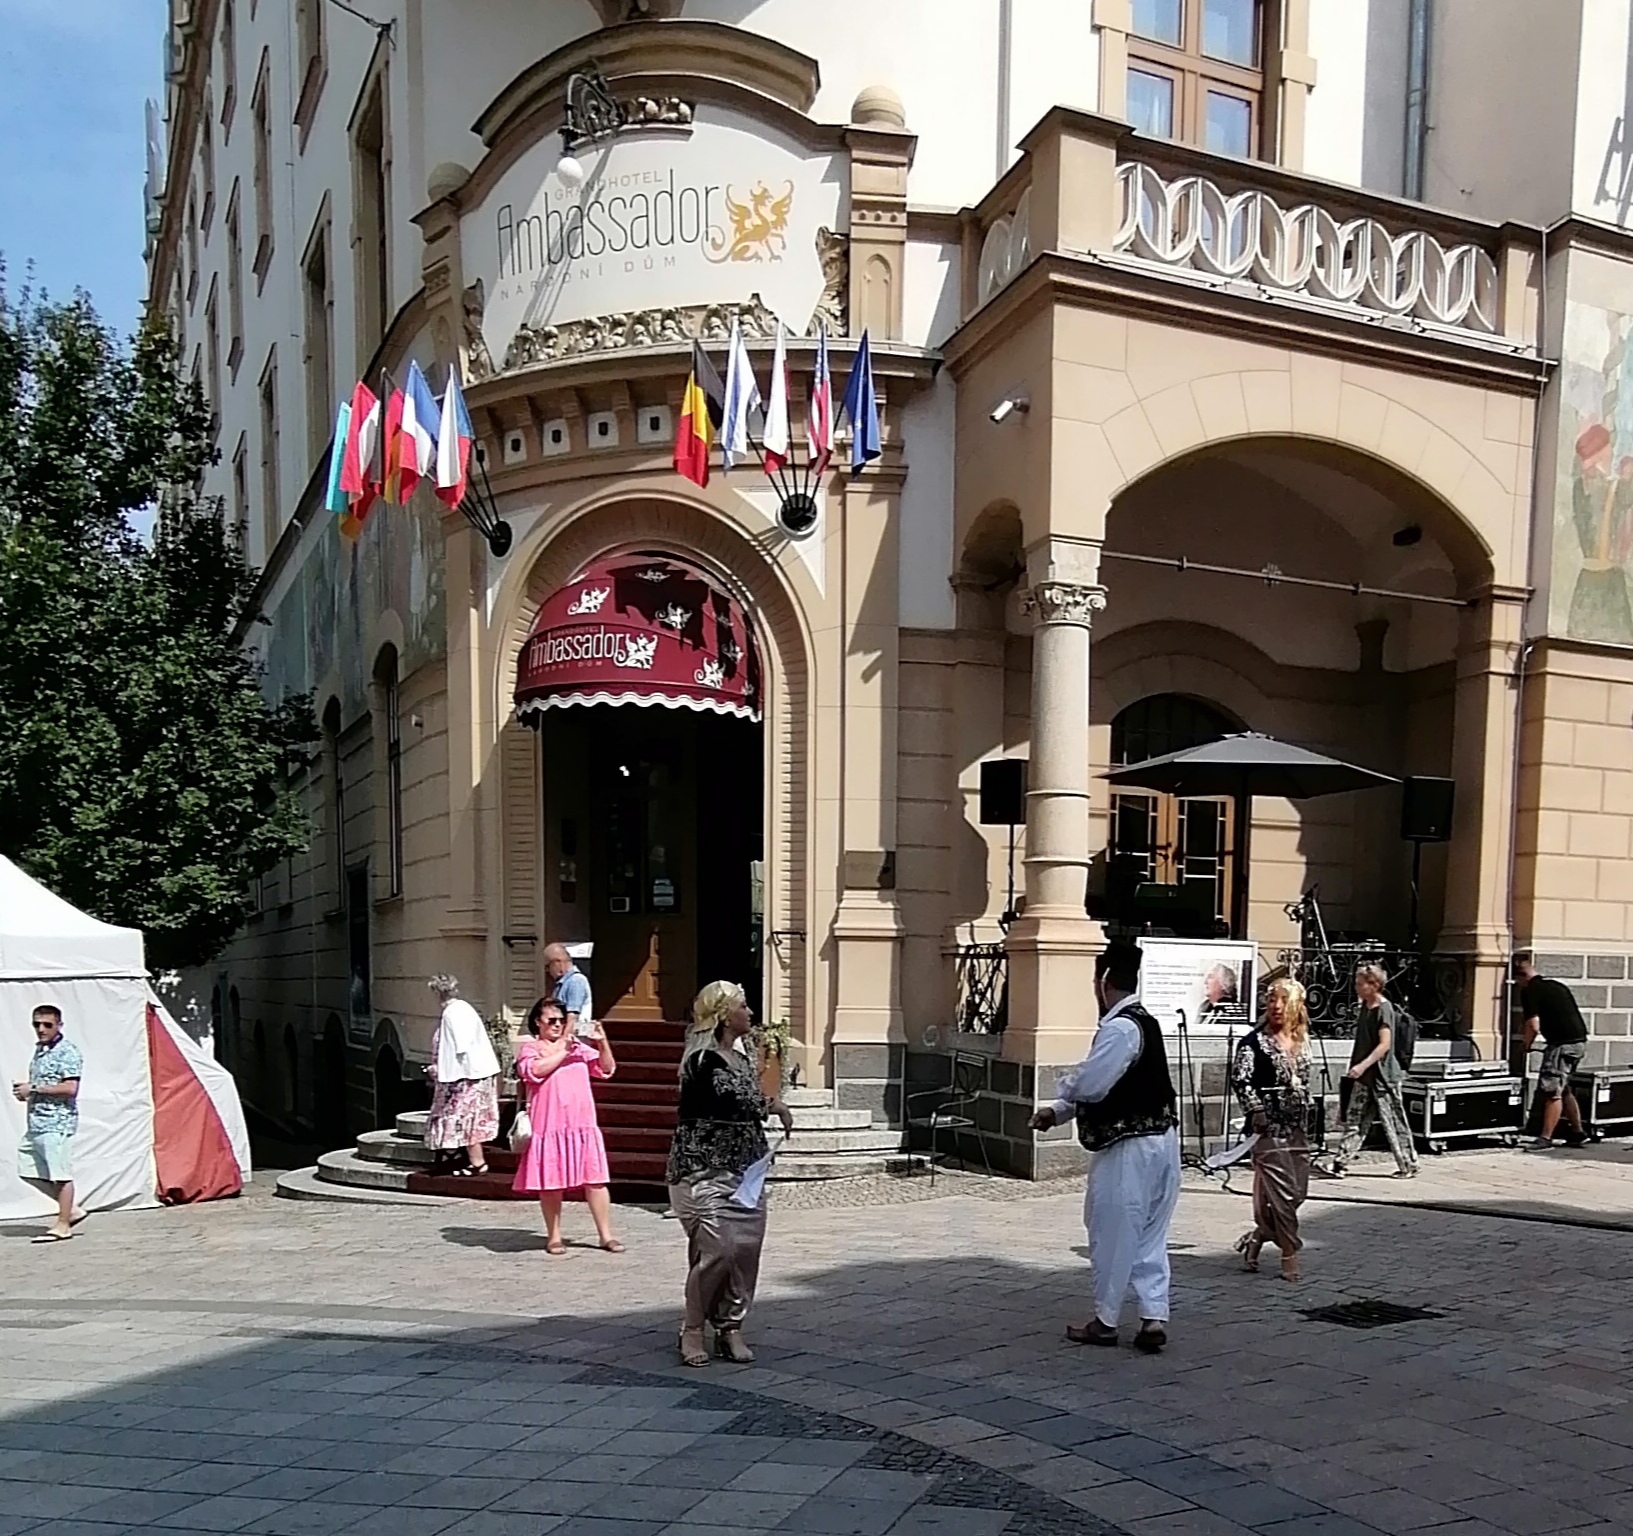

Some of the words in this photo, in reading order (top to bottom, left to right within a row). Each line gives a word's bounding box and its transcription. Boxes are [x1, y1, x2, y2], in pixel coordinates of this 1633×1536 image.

[554, 170, 663, 201] GRANDHOTEL
[497, 168, 720, 280] Ambassador
[501, 263, 605, 301] NÁRODNÍ
[624, 255, 677, 273] DŮM
[529, 625, 624, 669] Ambassador
